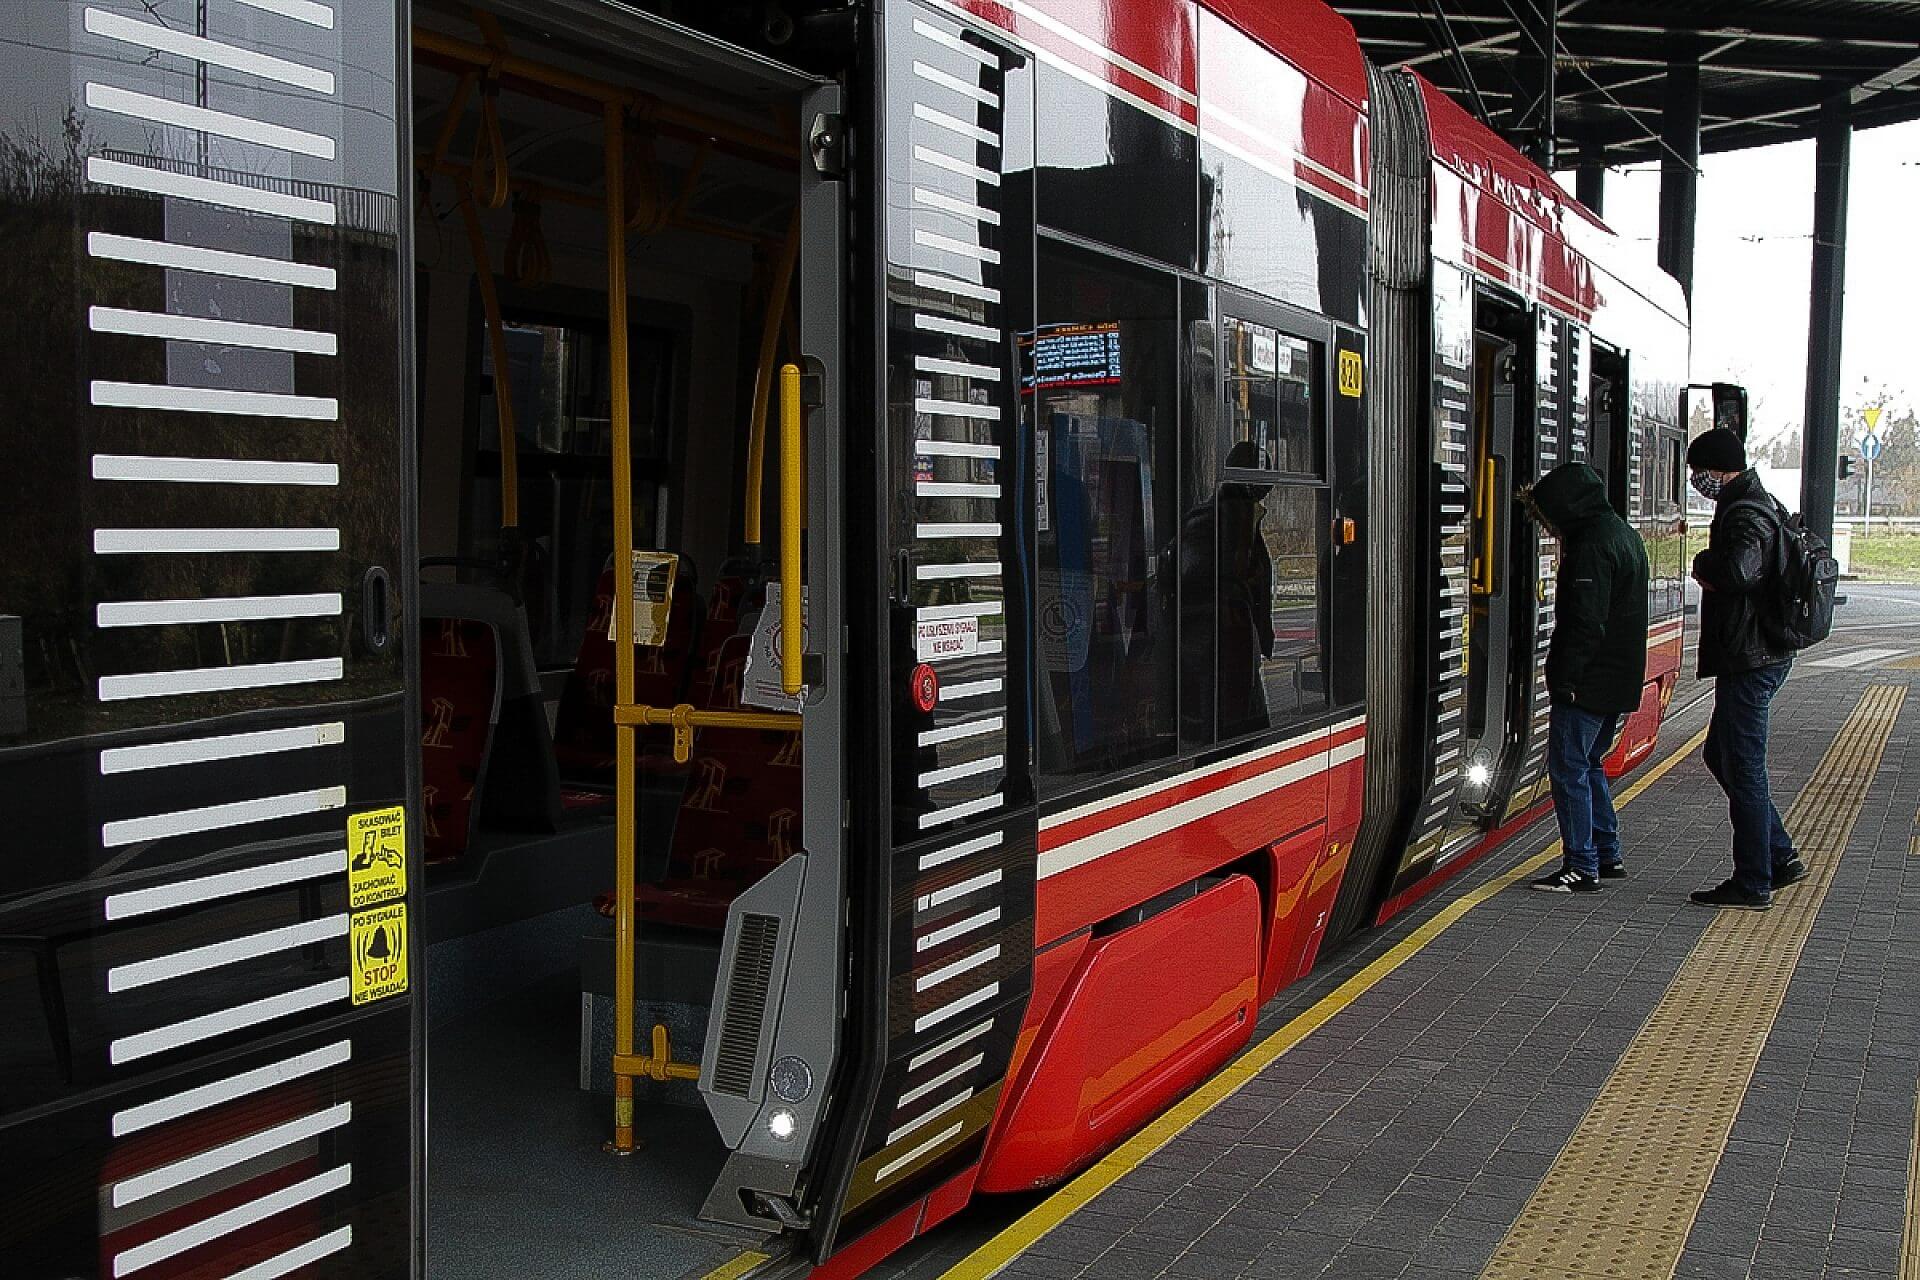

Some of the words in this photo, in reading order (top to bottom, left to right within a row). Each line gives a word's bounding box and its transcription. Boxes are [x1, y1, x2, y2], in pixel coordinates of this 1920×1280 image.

[357, 812, 401, 830] SKASOWAĆ
[380, 825, 402, 839] BILET
[352, 873, 396, 894] ZACHOWAĆ
[353, 894, 366, 906] DO
[353, 916, 366, 929] PO
[367, 906, 404, 926] SYGNALE
[364, 964, 397, 986] STOP
[355, 989, 369, 1003] NIE
[369, 978, 406, 999] WSIADAĆ
